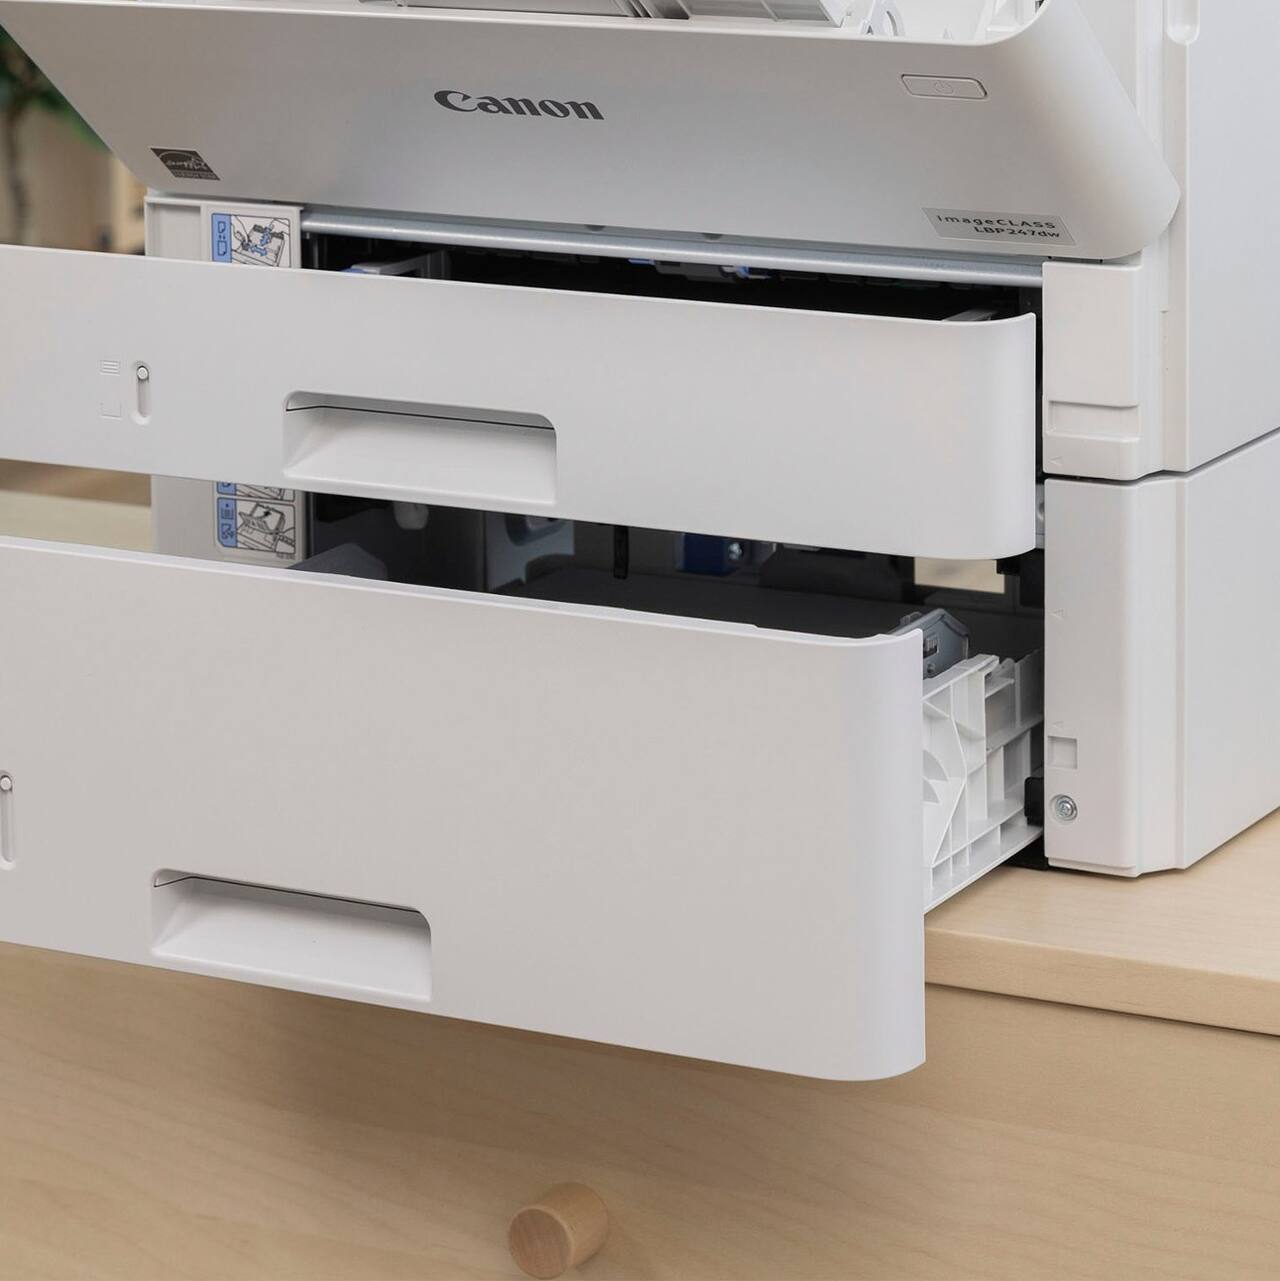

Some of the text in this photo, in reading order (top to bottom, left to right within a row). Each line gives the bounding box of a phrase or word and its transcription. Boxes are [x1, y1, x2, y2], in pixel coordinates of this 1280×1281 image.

[433, 90, 605, 120] Canon
[936, 214, 1056, 229] imageCLASS
[973, 226, 1060, 238] LBP247dw
